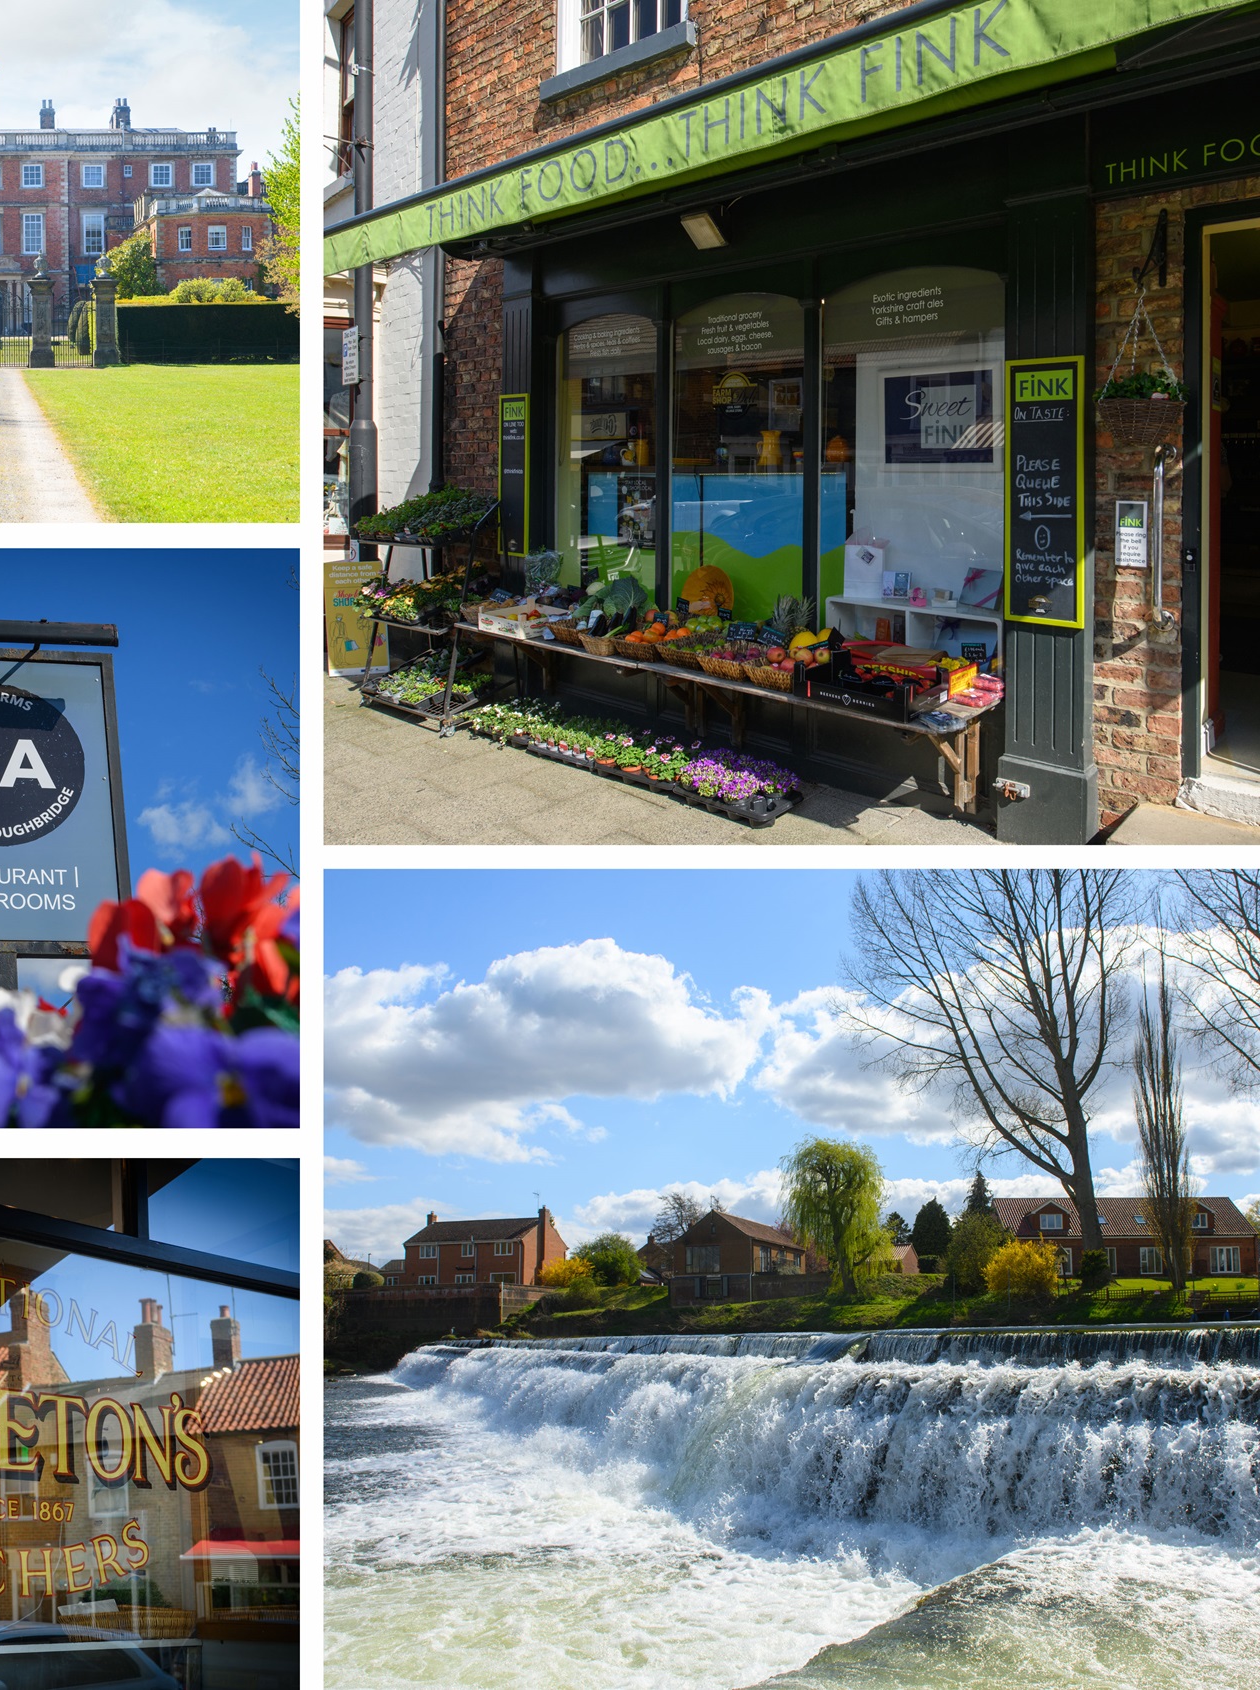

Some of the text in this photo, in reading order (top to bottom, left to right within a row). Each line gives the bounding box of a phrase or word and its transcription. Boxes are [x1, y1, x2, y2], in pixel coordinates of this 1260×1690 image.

[425, 179, 505, 238] THINK
[678, 63, 827, 158] THINK
[860, 0, 1011, 103] FINK
[1105, 148, 1189, 184] THINK
[872, 286, 942, 303] Exotic ingredients
[870, 298, 944, 315] Yorkshire craft ales
[707, 310, 763, 324] Traditional grocery
[875, 312, 939, 327] Gifts & hampers
[701, 320, 769, 335] Fresh fruit & vegetables
[697, 337, 714, 346] Local
[730, 333, 748, 343] eggs,
[748, 331, 774, 341] cheese,
[707, 342, 763, 355] sausages & bacon
[712, 388, 732, 397] FARM
[712, 396, 732, 405] SHOP
[900, 390, 973, 420] Sweet
[1014, 407, 1027, 420] ON
[1016, 454, 1061, 472] PLEASE
[1015, 474, 1061, 490] QUEUE
[1018, 492, 1071, 508] THIS SIDE
[1063, 551, 1075, 564] to
[1038, 563, 1066, 575] each
[1044, 576, 1075, 589] space
[31, 1501, 75, 1523] 1867
